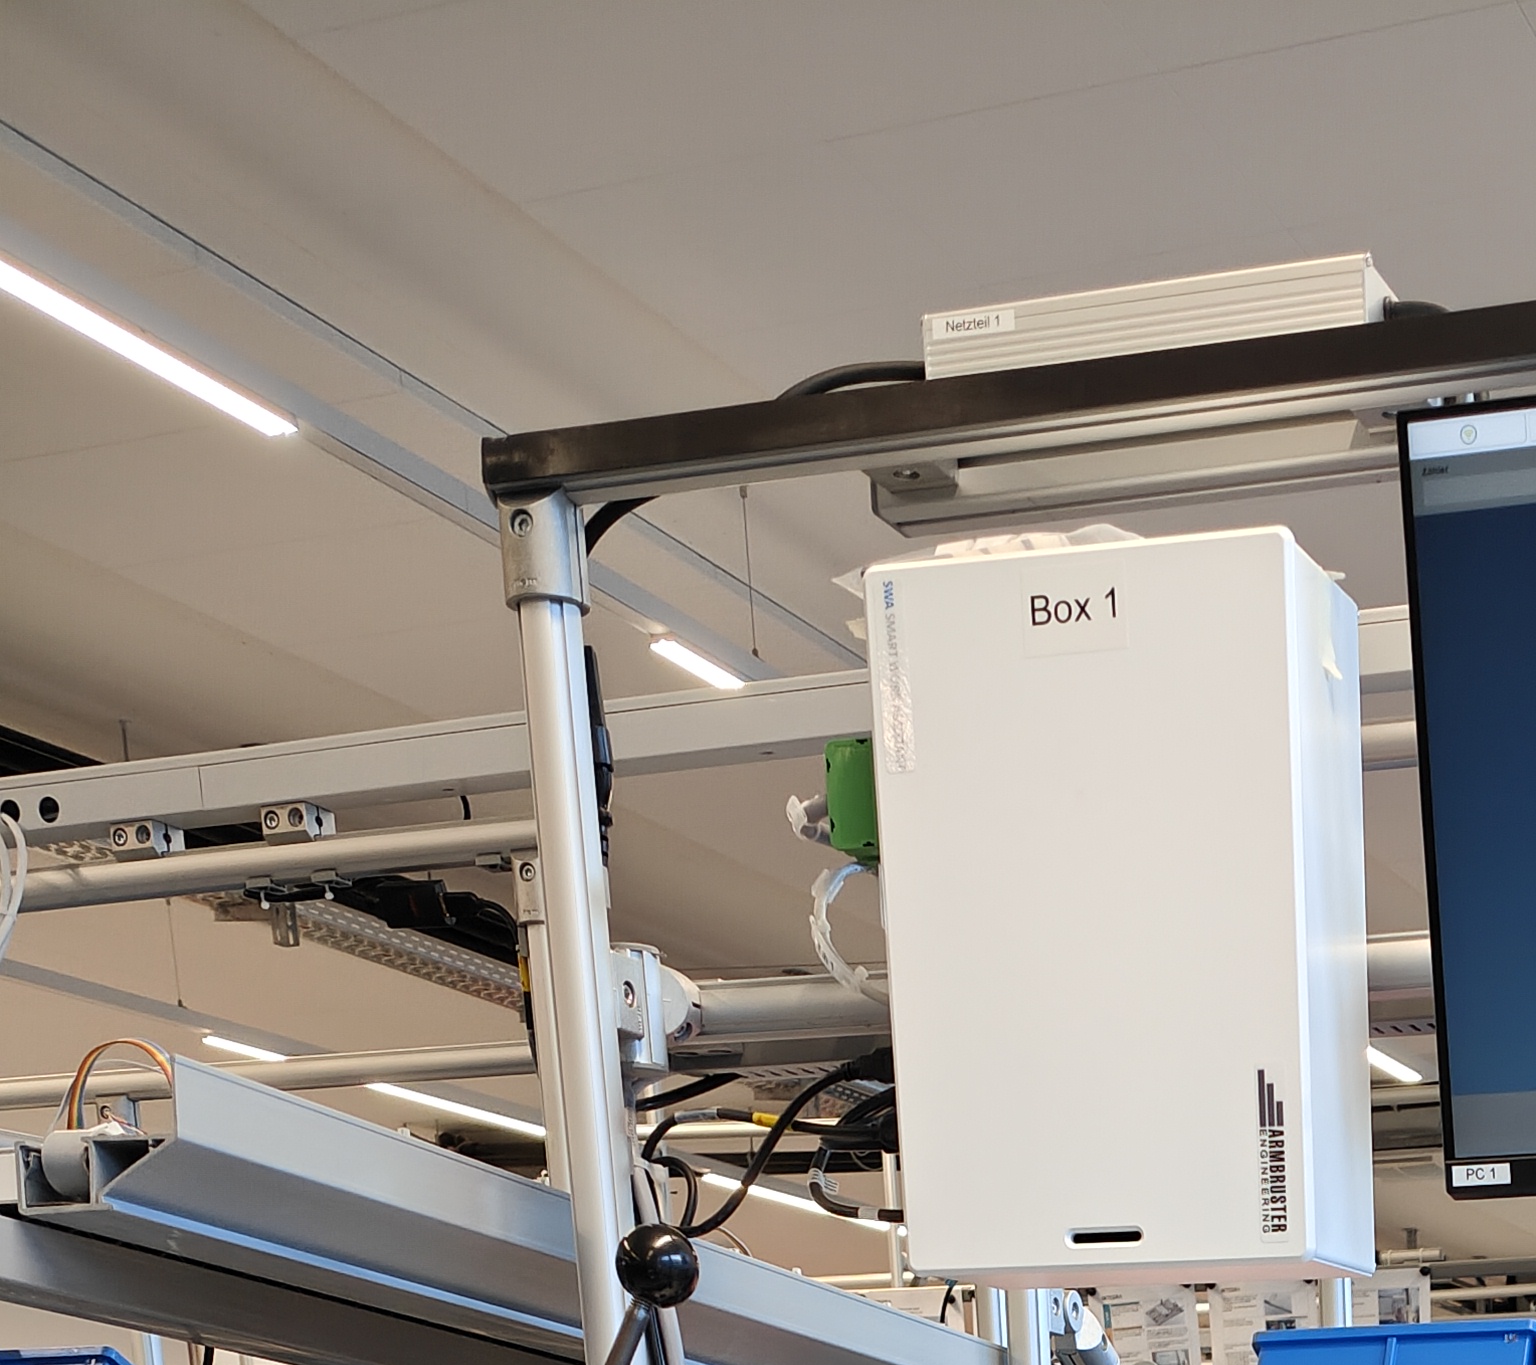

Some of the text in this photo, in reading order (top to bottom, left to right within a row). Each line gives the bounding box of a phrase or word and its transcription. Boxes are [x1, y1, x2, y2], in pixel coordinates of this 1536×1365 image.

[945, 314, 1001, 333] Netzteil 1
[883, 581, 895, 610] SWA
[1029, 587, 1119, 626] Box 1
[1258, 1129, 1271, 1234] ENGINEERING
[1267, 1129, 1287, 1235] ARMBRUSTER
[1465, 1166, 1496, 1181] PC 1
